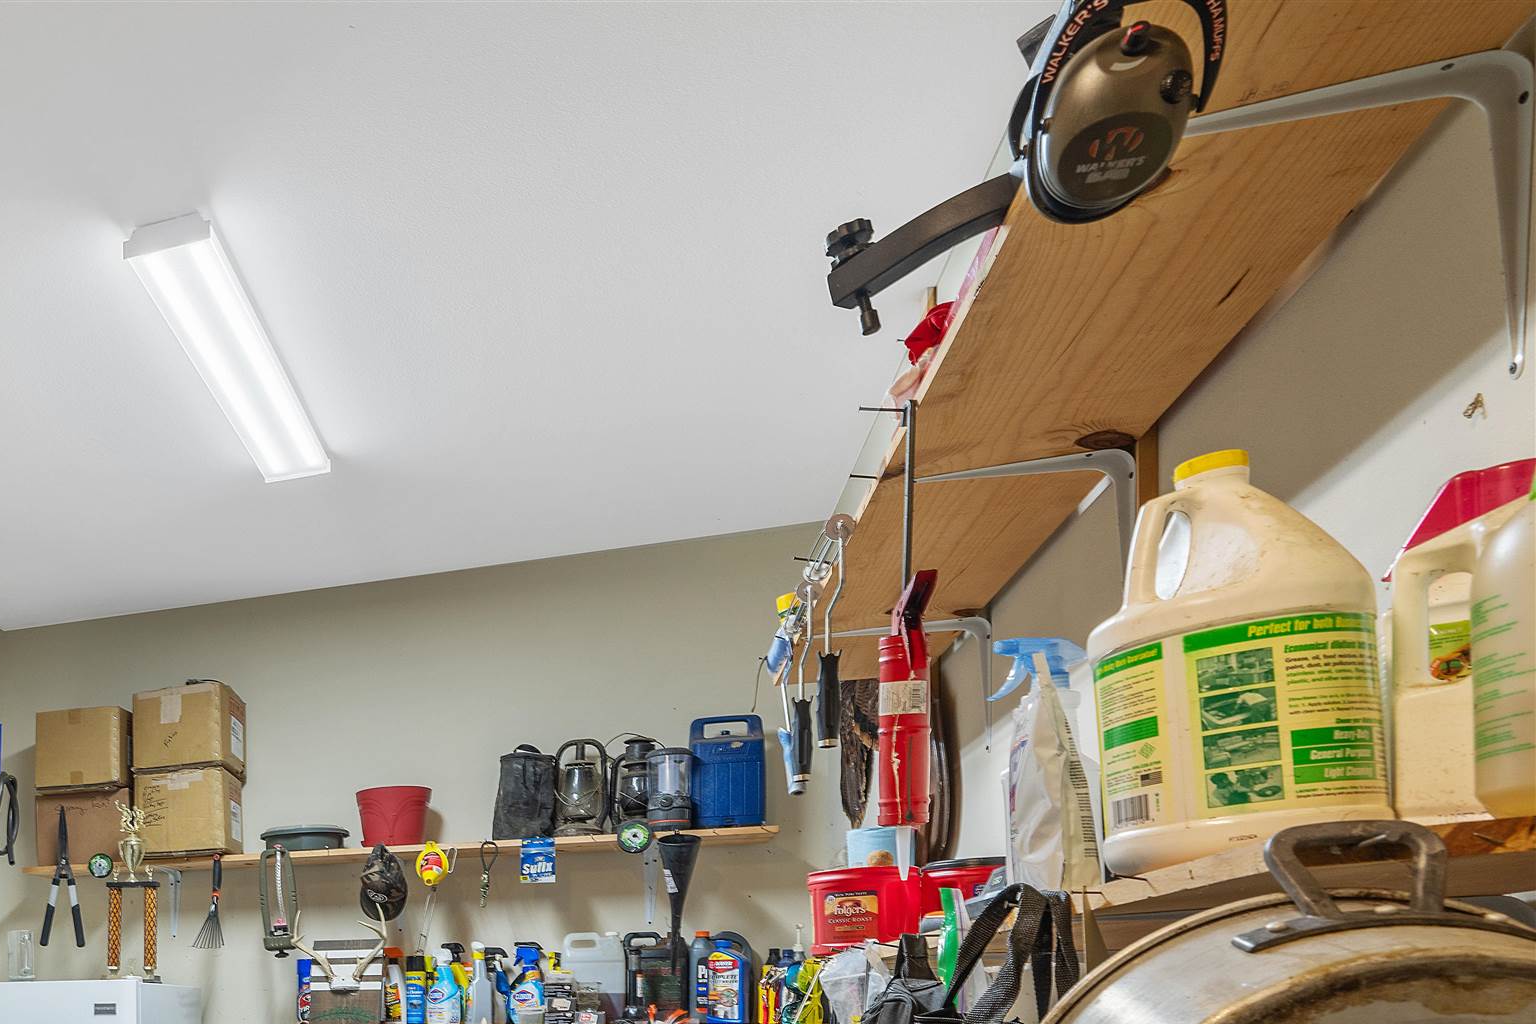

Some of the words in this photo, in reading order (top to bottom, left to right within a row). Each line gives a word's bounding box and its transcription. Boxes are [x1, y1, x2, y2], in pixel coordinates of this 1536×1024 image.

[1040, 0, 1109, 84] WALKER'S
[1248, 621, 1292, 637] Perfect
[1294, 619, 1311, 631] for
[522, 861, 554, 875] Sufix
[833, 902, 867, 917] Folgers
